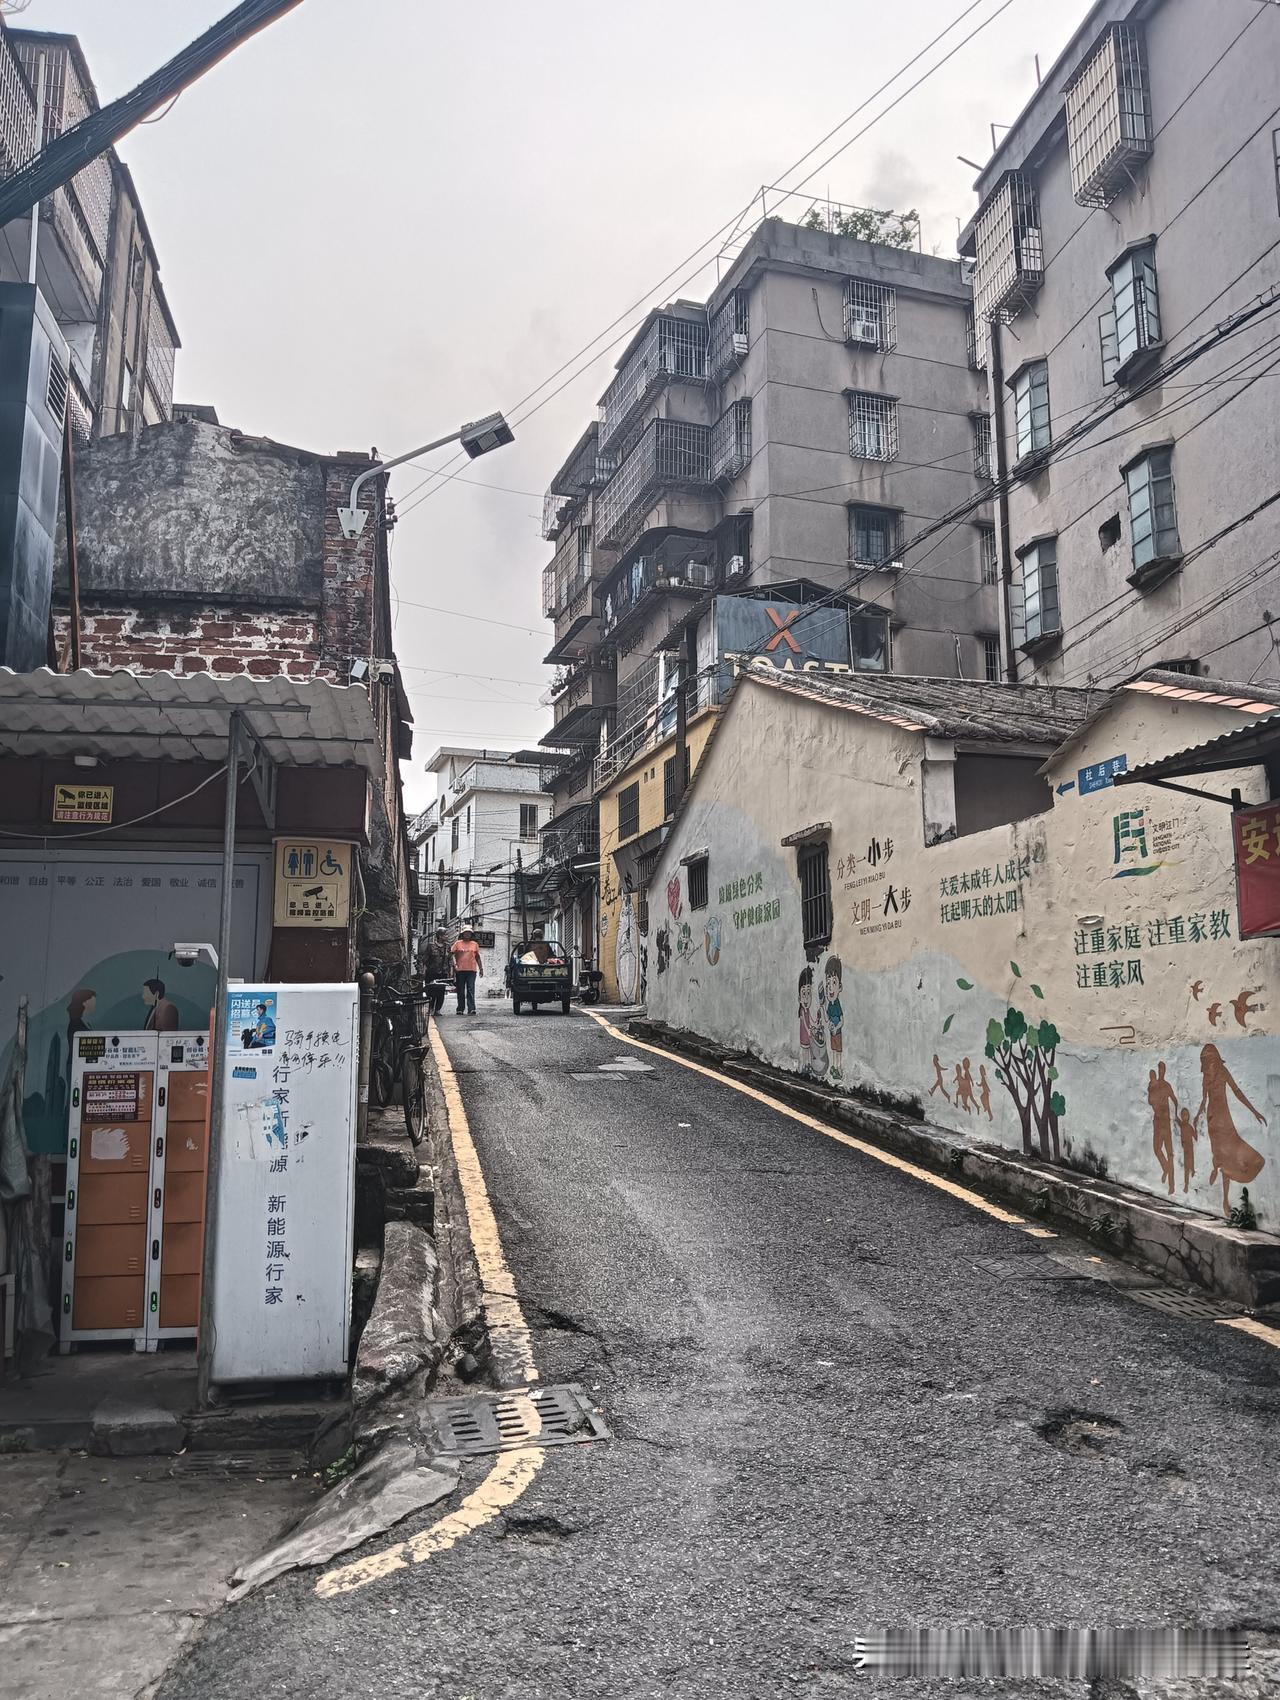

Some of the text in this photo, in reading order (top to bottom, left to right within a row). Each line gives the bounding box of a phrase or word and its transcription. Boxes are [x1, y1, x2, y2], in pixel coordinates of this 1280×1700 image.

[763, 607, 802, 653] X
[1085, 760, 1120, 781] 社后巷
[837, 837, 894, 880] 分类一小步
[1242, 814, 1280, 864] 安
[28, 876, 48, 886] 自由
[84, 876, 105, 887] 公正
[940, 857, 1030, 898] 关爱未成年人成长
[733, 898, 780, 930] 守护健康家园
[850, 885, 912, 925] 文明一大步
[941, 890, 1018, 924] 托起明天的太阳
[1074, 908, 1232, 956] 注重家庭 注重家教
[1075, 958, 1145, 989] 注重家风
[264, 1194, 288, 1304] 新能源行家
